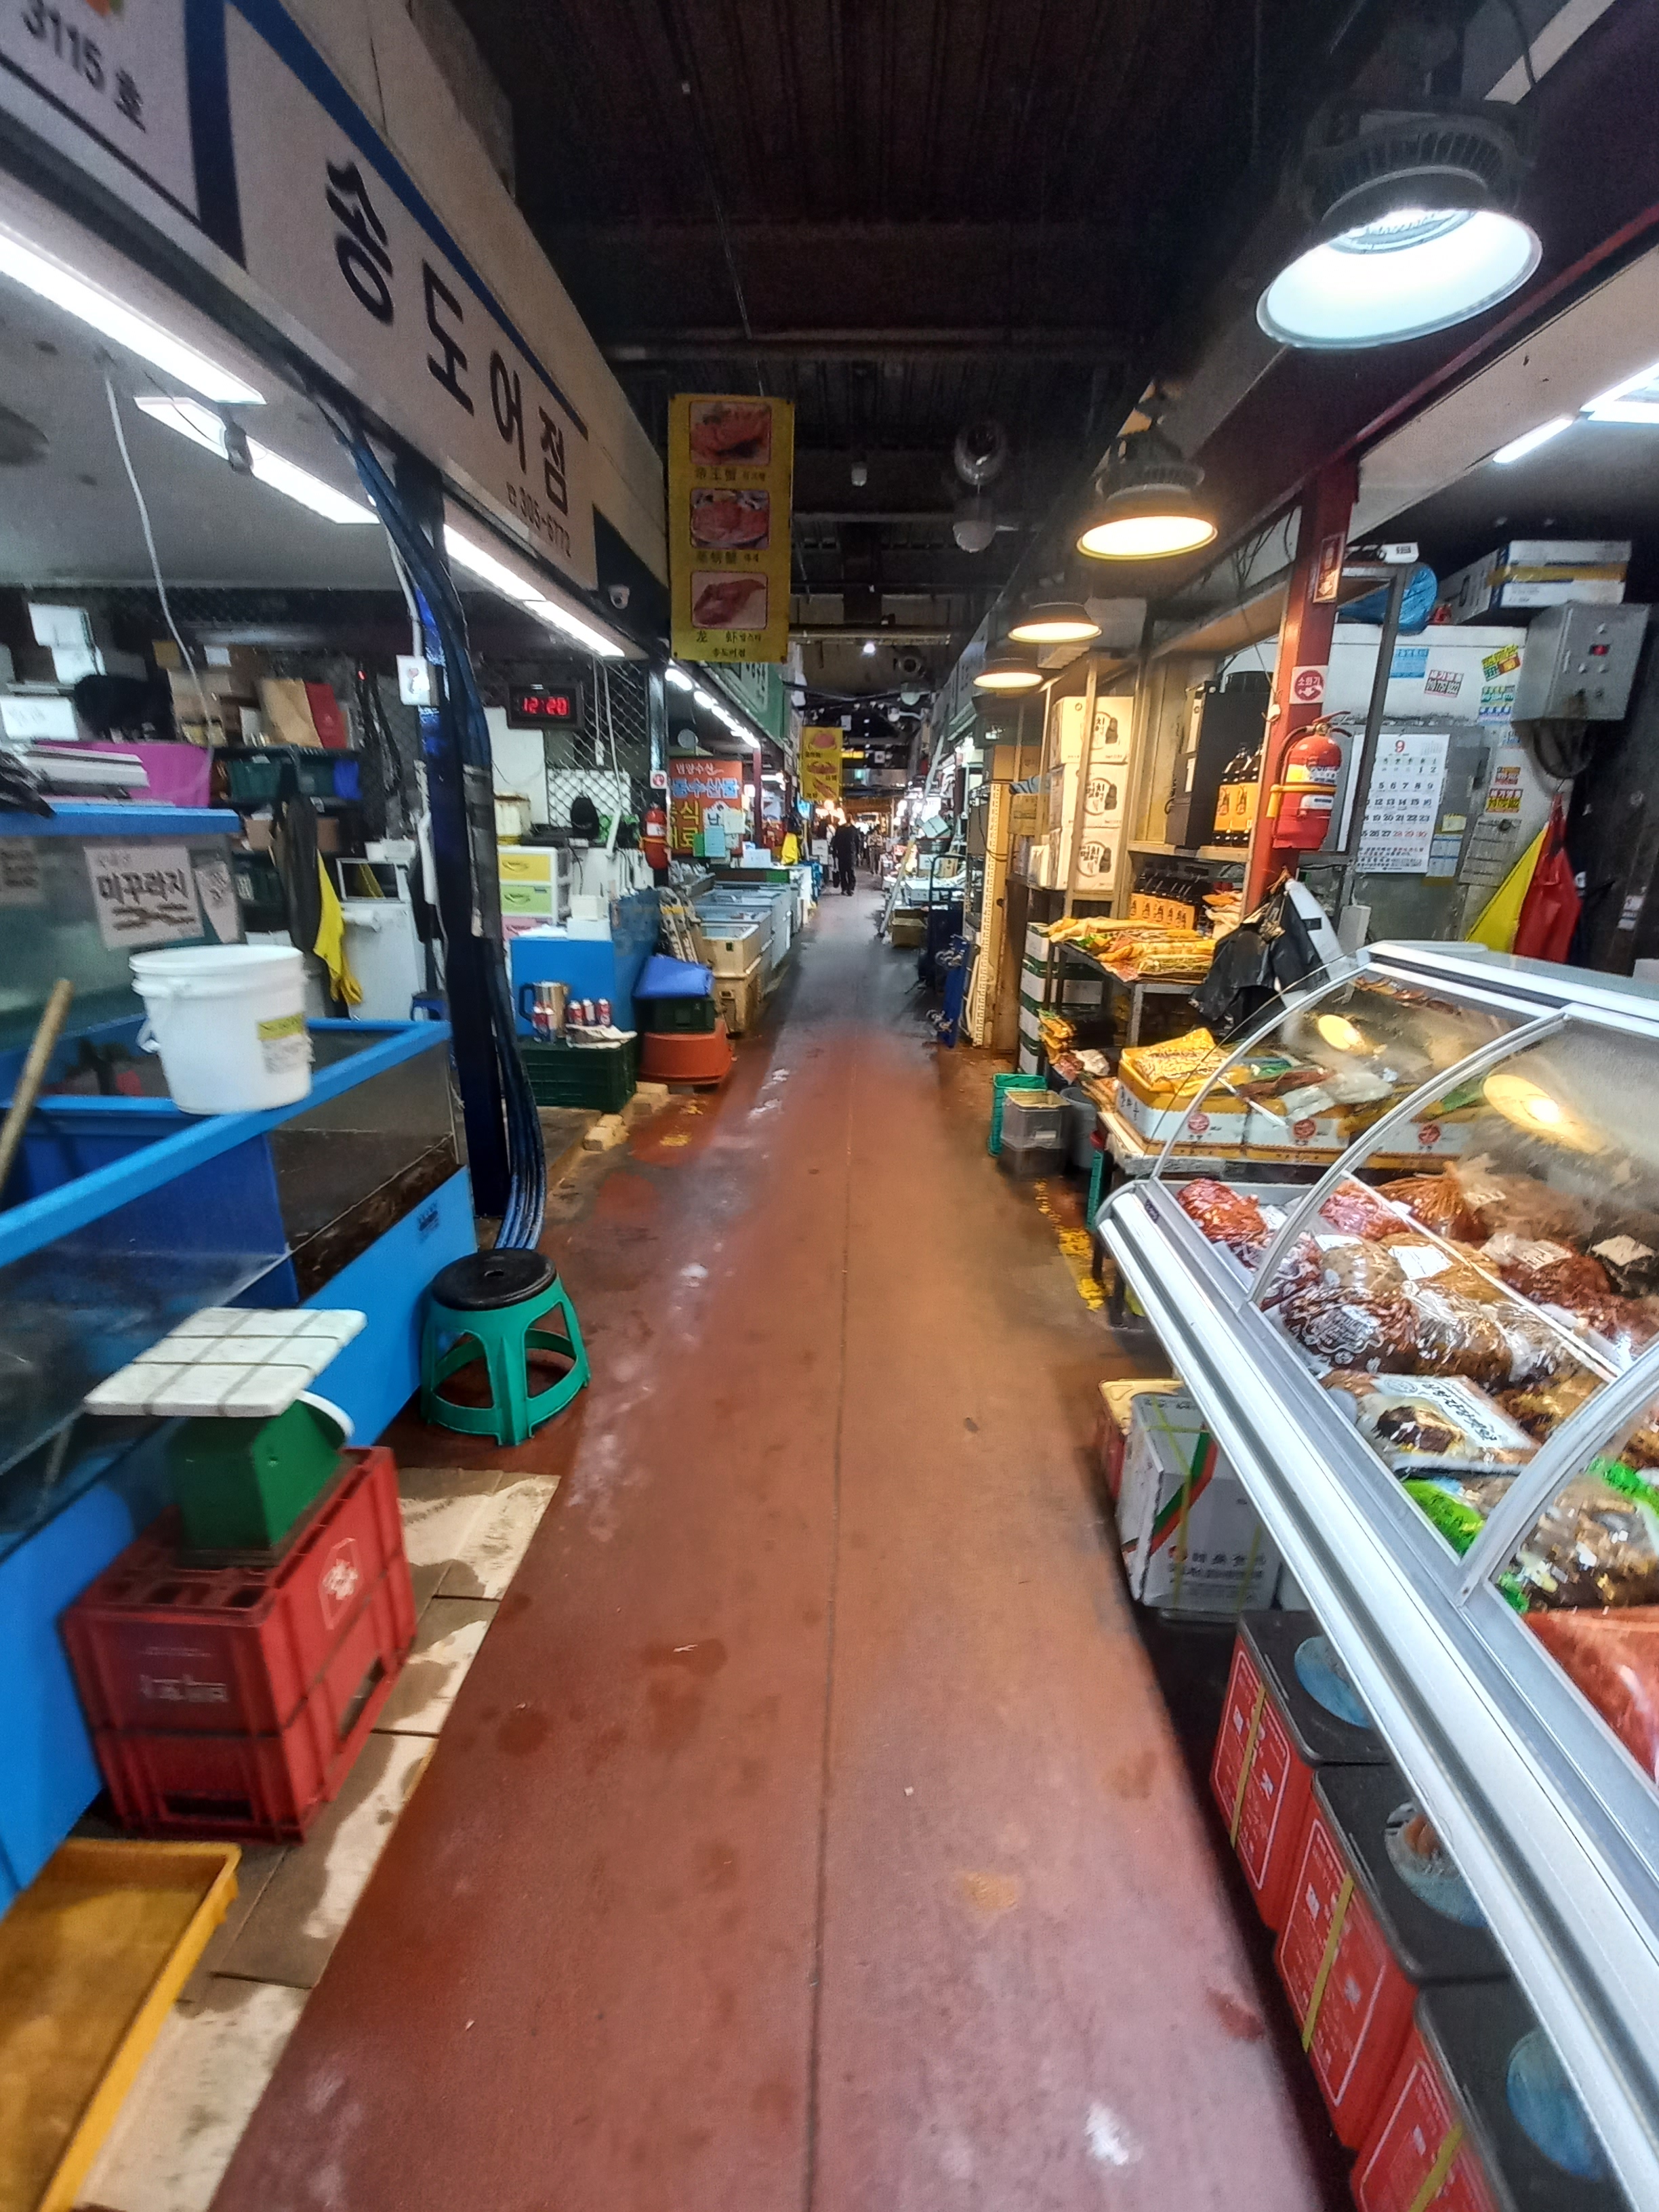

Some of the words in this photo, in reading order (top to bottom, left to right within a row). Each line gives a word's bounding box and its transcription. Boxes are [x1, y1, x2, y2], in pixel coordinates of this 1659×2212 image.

[326, 159, 569, 516] 송도어점
[1297, 676, 1322, 687] 소화기
[1395, 739, 1406, 753] 9
